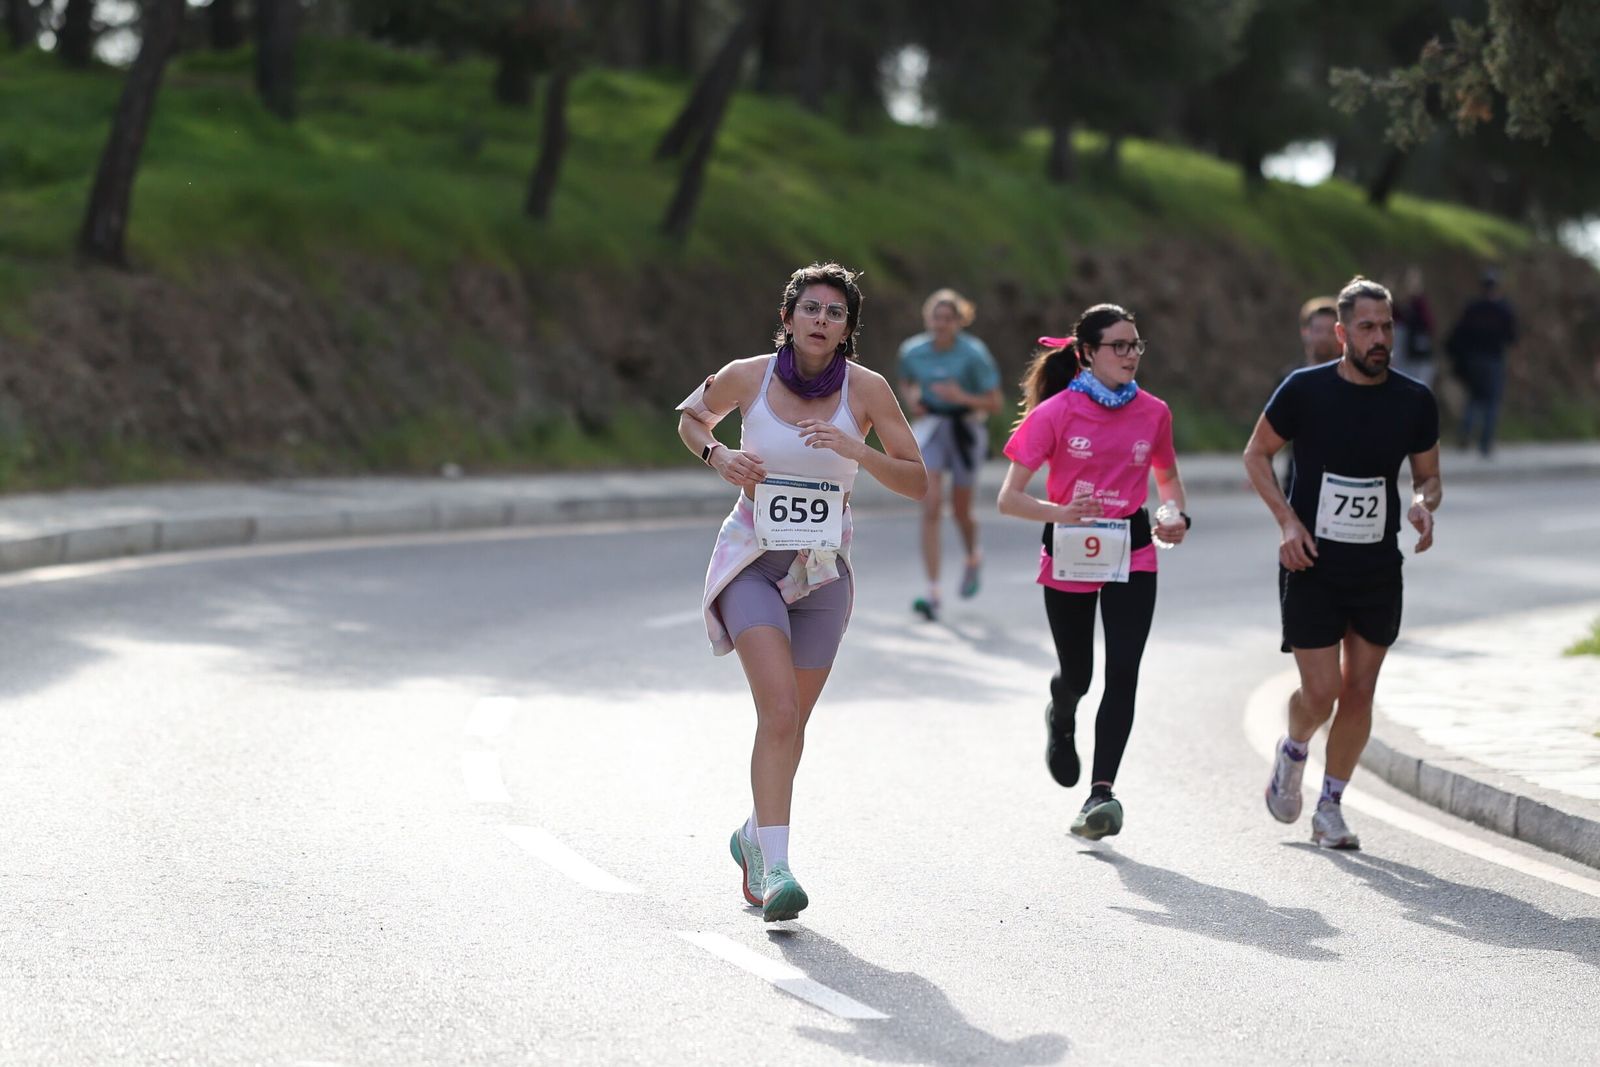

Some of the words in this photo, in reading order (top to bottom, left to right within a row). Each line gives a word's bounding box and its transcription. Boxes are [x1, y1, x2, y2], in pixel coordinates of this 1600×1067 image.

[770, 495, 829, 523] 659
[1334, 494, 1378, 518] 752
[1085, 536, 1101, 558] 9
